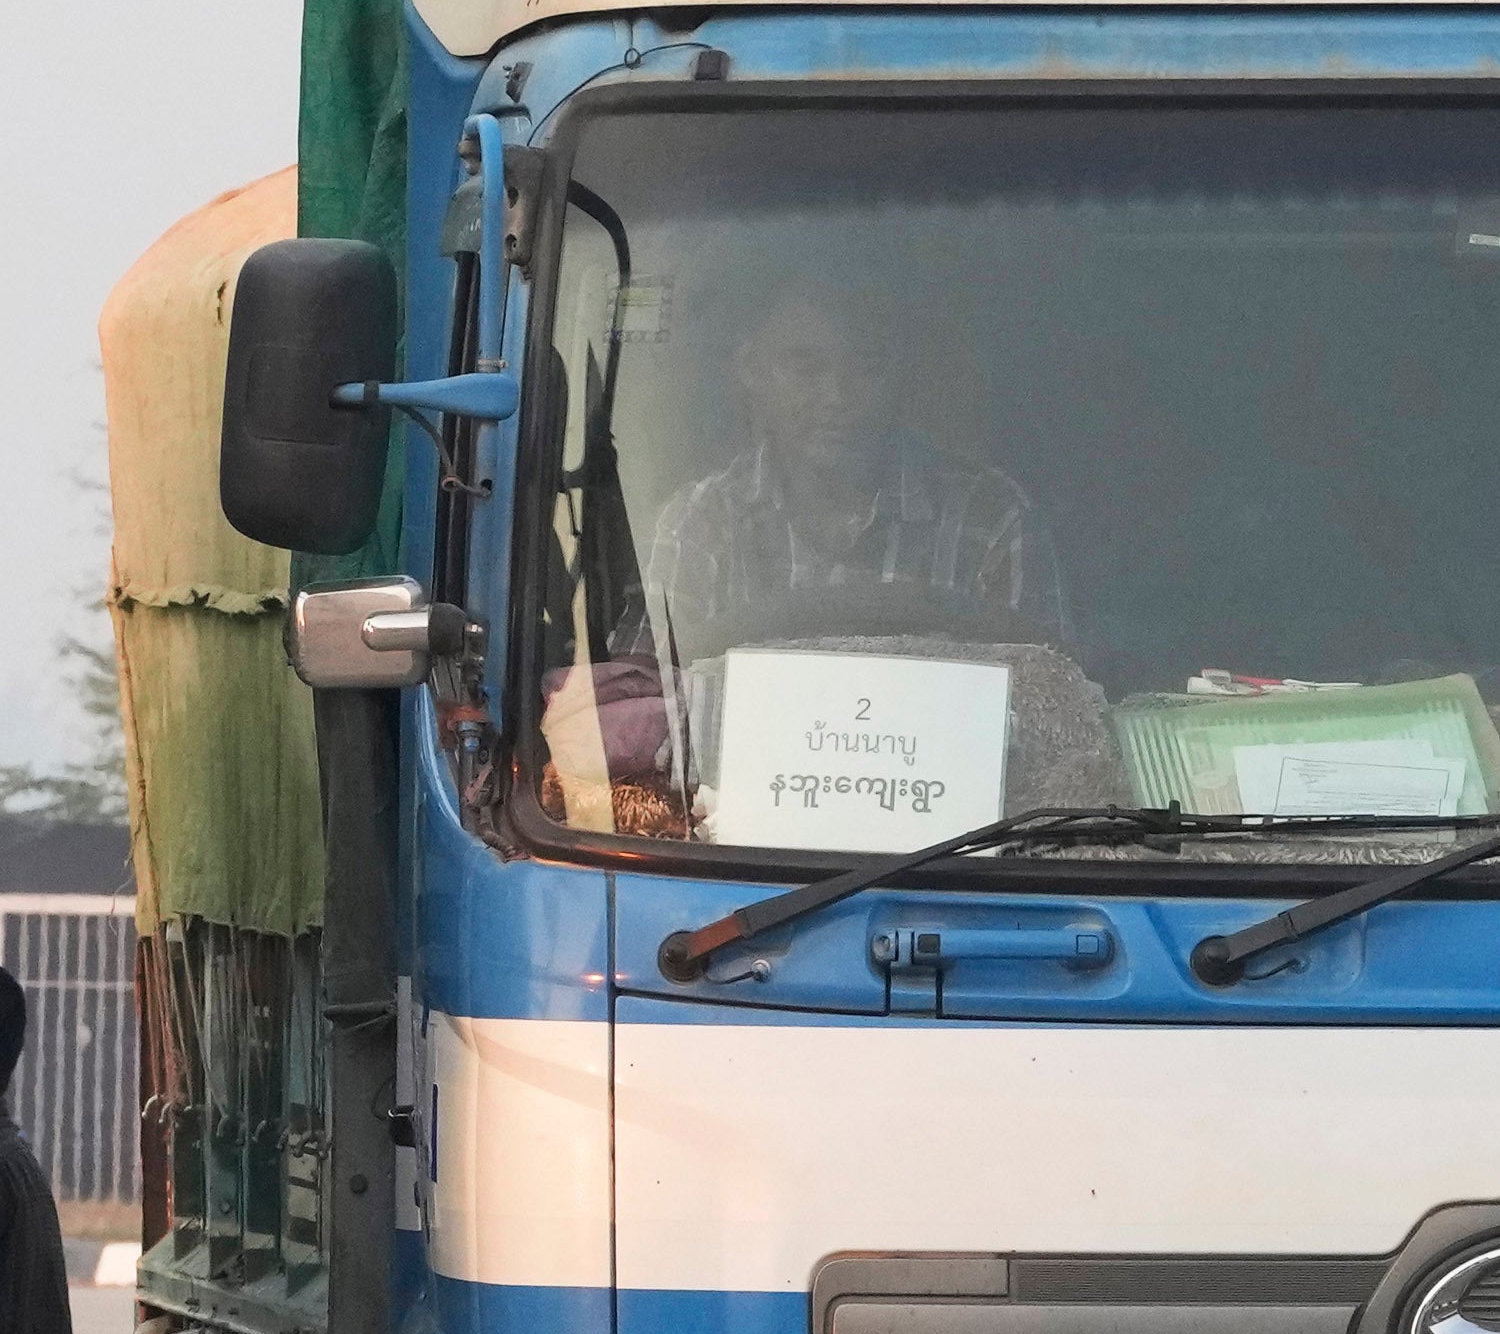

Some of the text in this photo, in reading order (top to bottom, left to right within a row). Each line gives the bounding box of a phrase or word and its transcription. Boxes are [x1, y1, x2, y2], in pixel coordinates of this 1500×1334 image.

[855, 698, 871, 721] 2
[805, 720, 917, 766] บ้านนาบู
